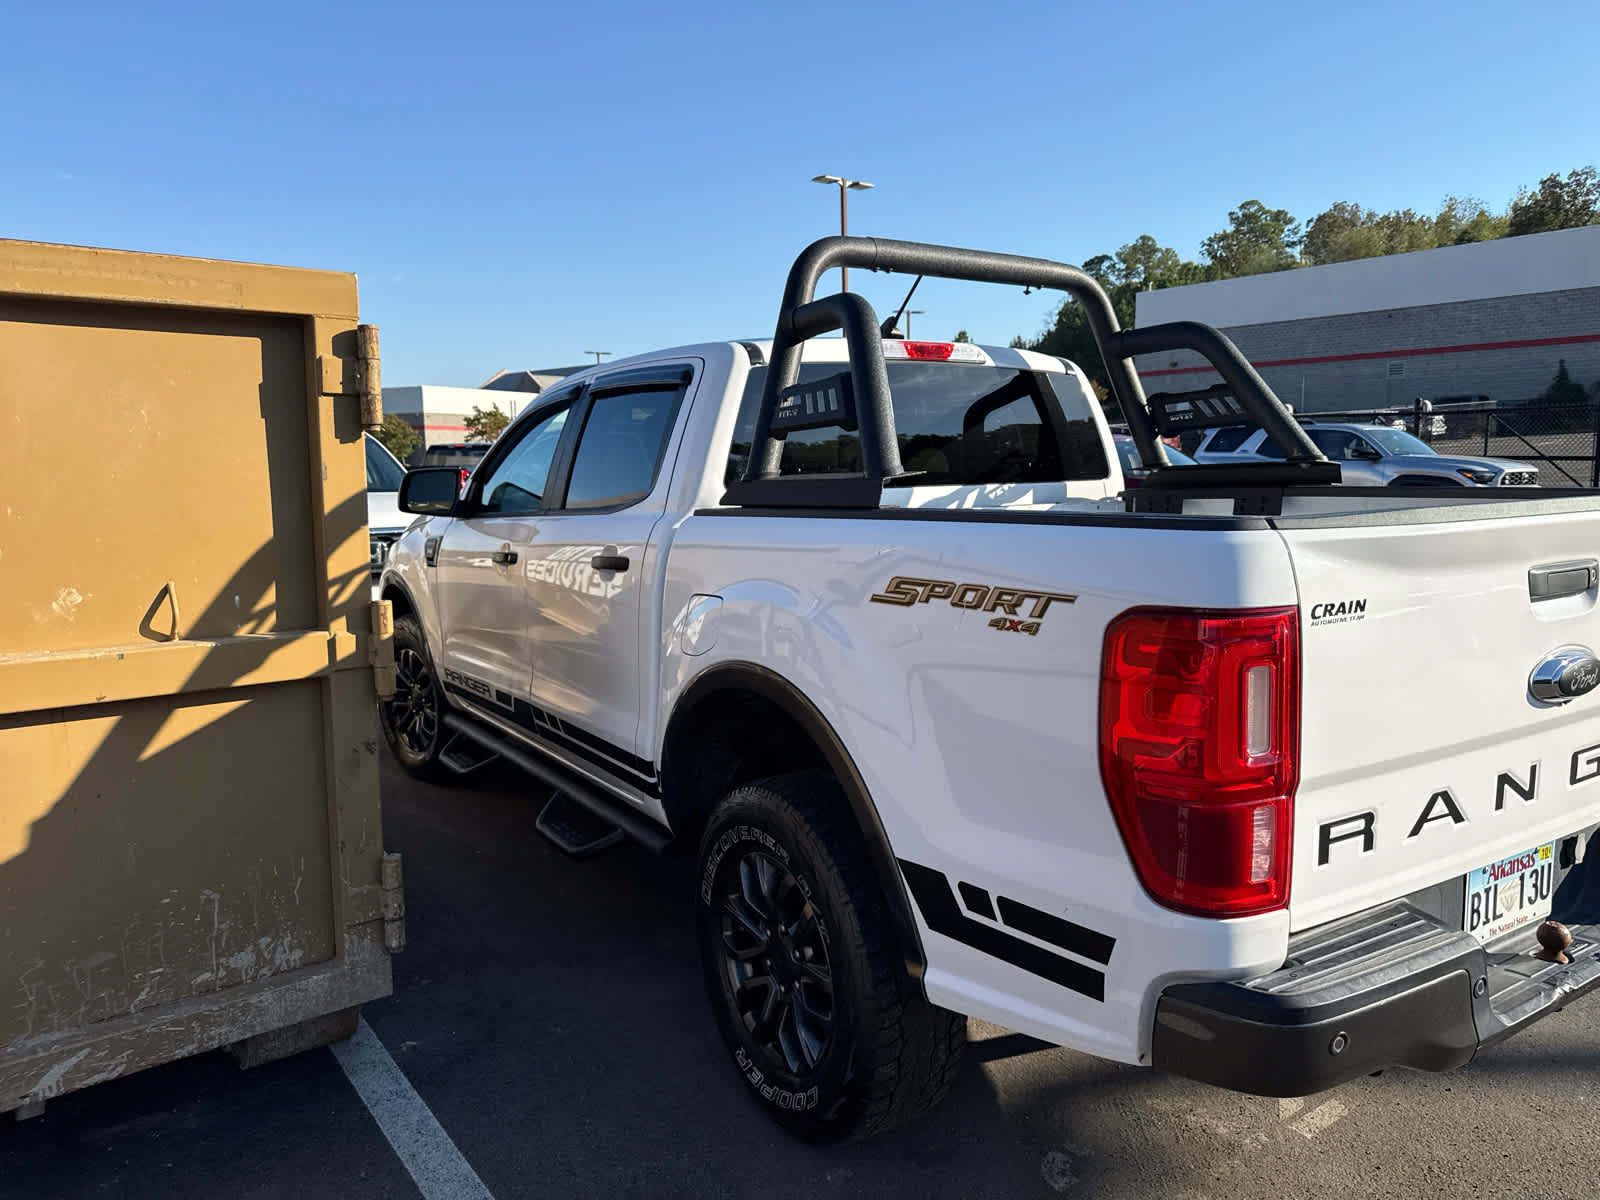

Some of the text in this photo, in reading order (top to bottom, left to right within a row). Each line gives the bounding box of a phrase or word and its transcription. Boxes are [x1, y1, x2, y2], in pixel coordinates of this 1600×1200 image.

[870, 576, 1079, 619] SPORT
[1310, 598, 1367, 620] CRAIN
[1570, 667, 1599, 691] Ford
[701, 825, 790, 905] DISCOVERER
[1487, 852, 1536, 884] Arkansas
[1469, 862, 1552, 932] BIL 13U
[735, 1047, 818, 1111] COOPER
